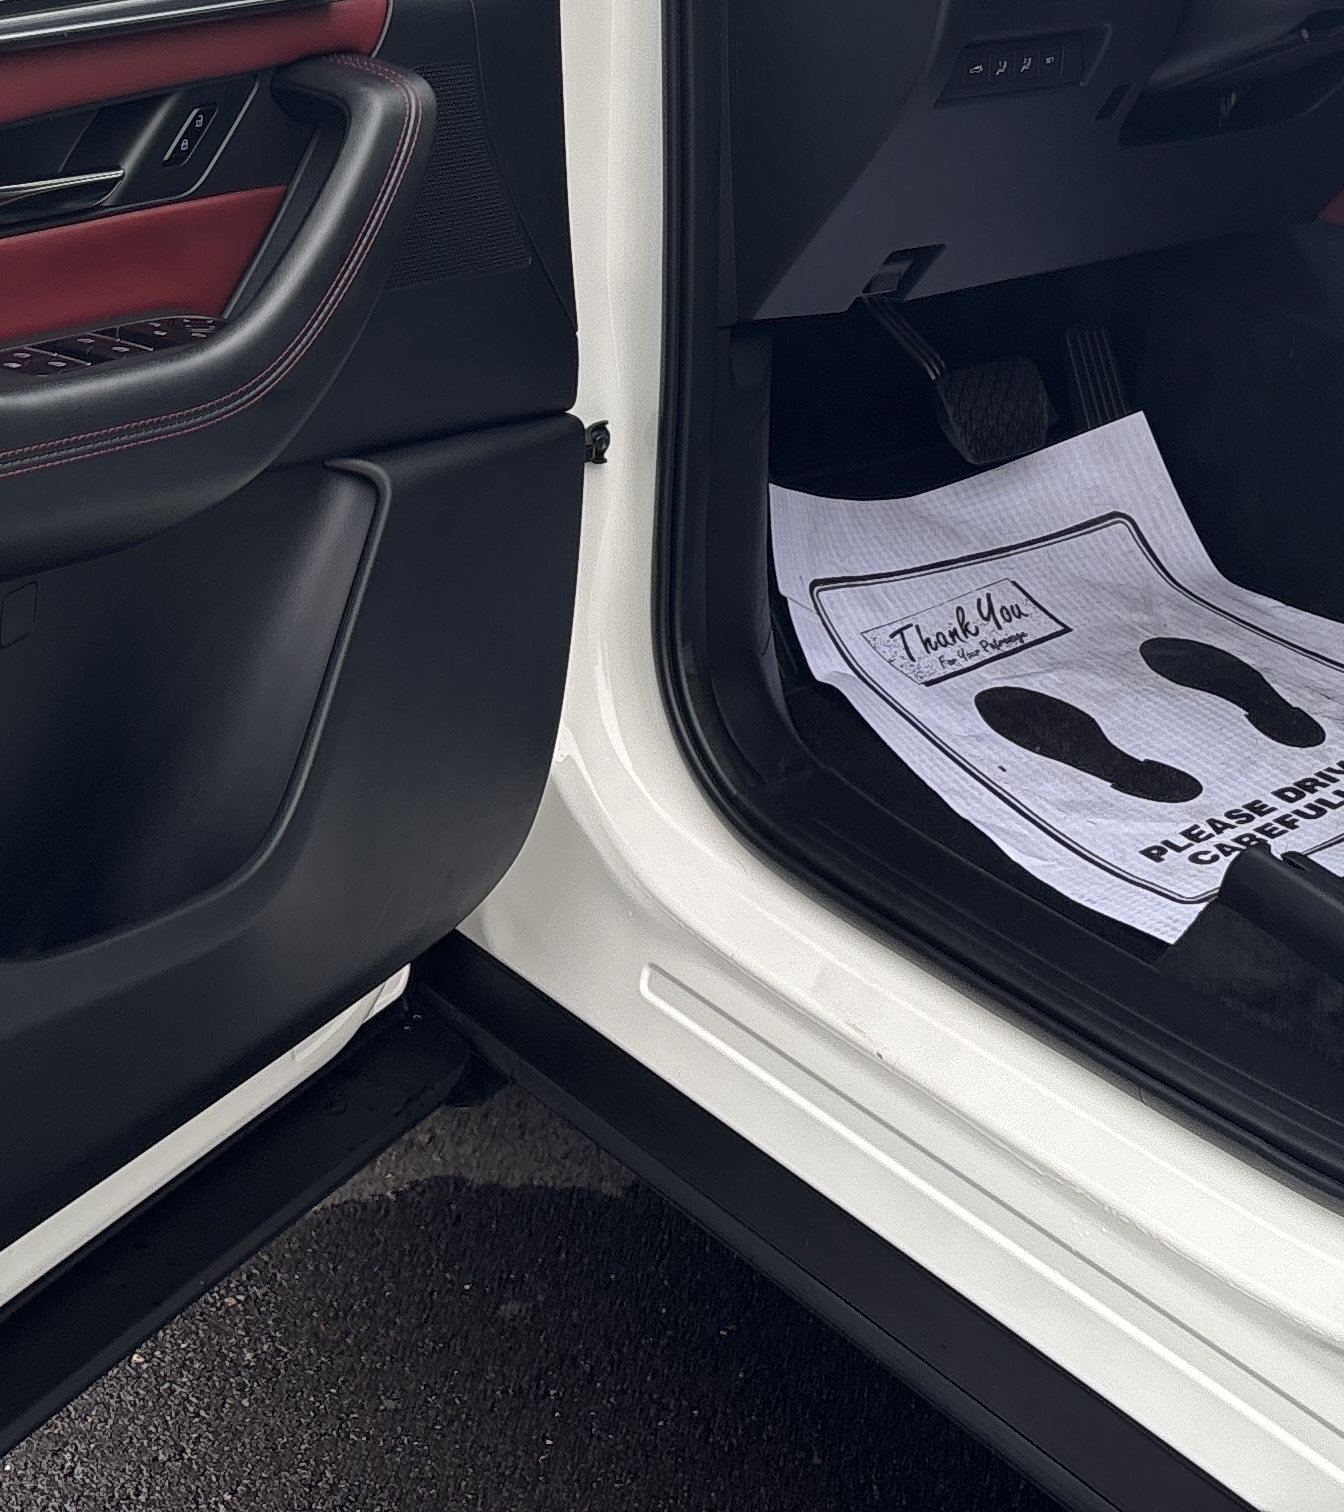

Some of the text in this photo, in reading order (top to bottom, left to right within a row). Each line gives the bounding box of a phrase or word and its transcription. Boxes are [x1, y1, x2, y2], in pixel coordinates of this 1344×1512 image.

[889, 592, 1030, 662] Thank You
[1138, 799, 1278, 863] PLEASE
